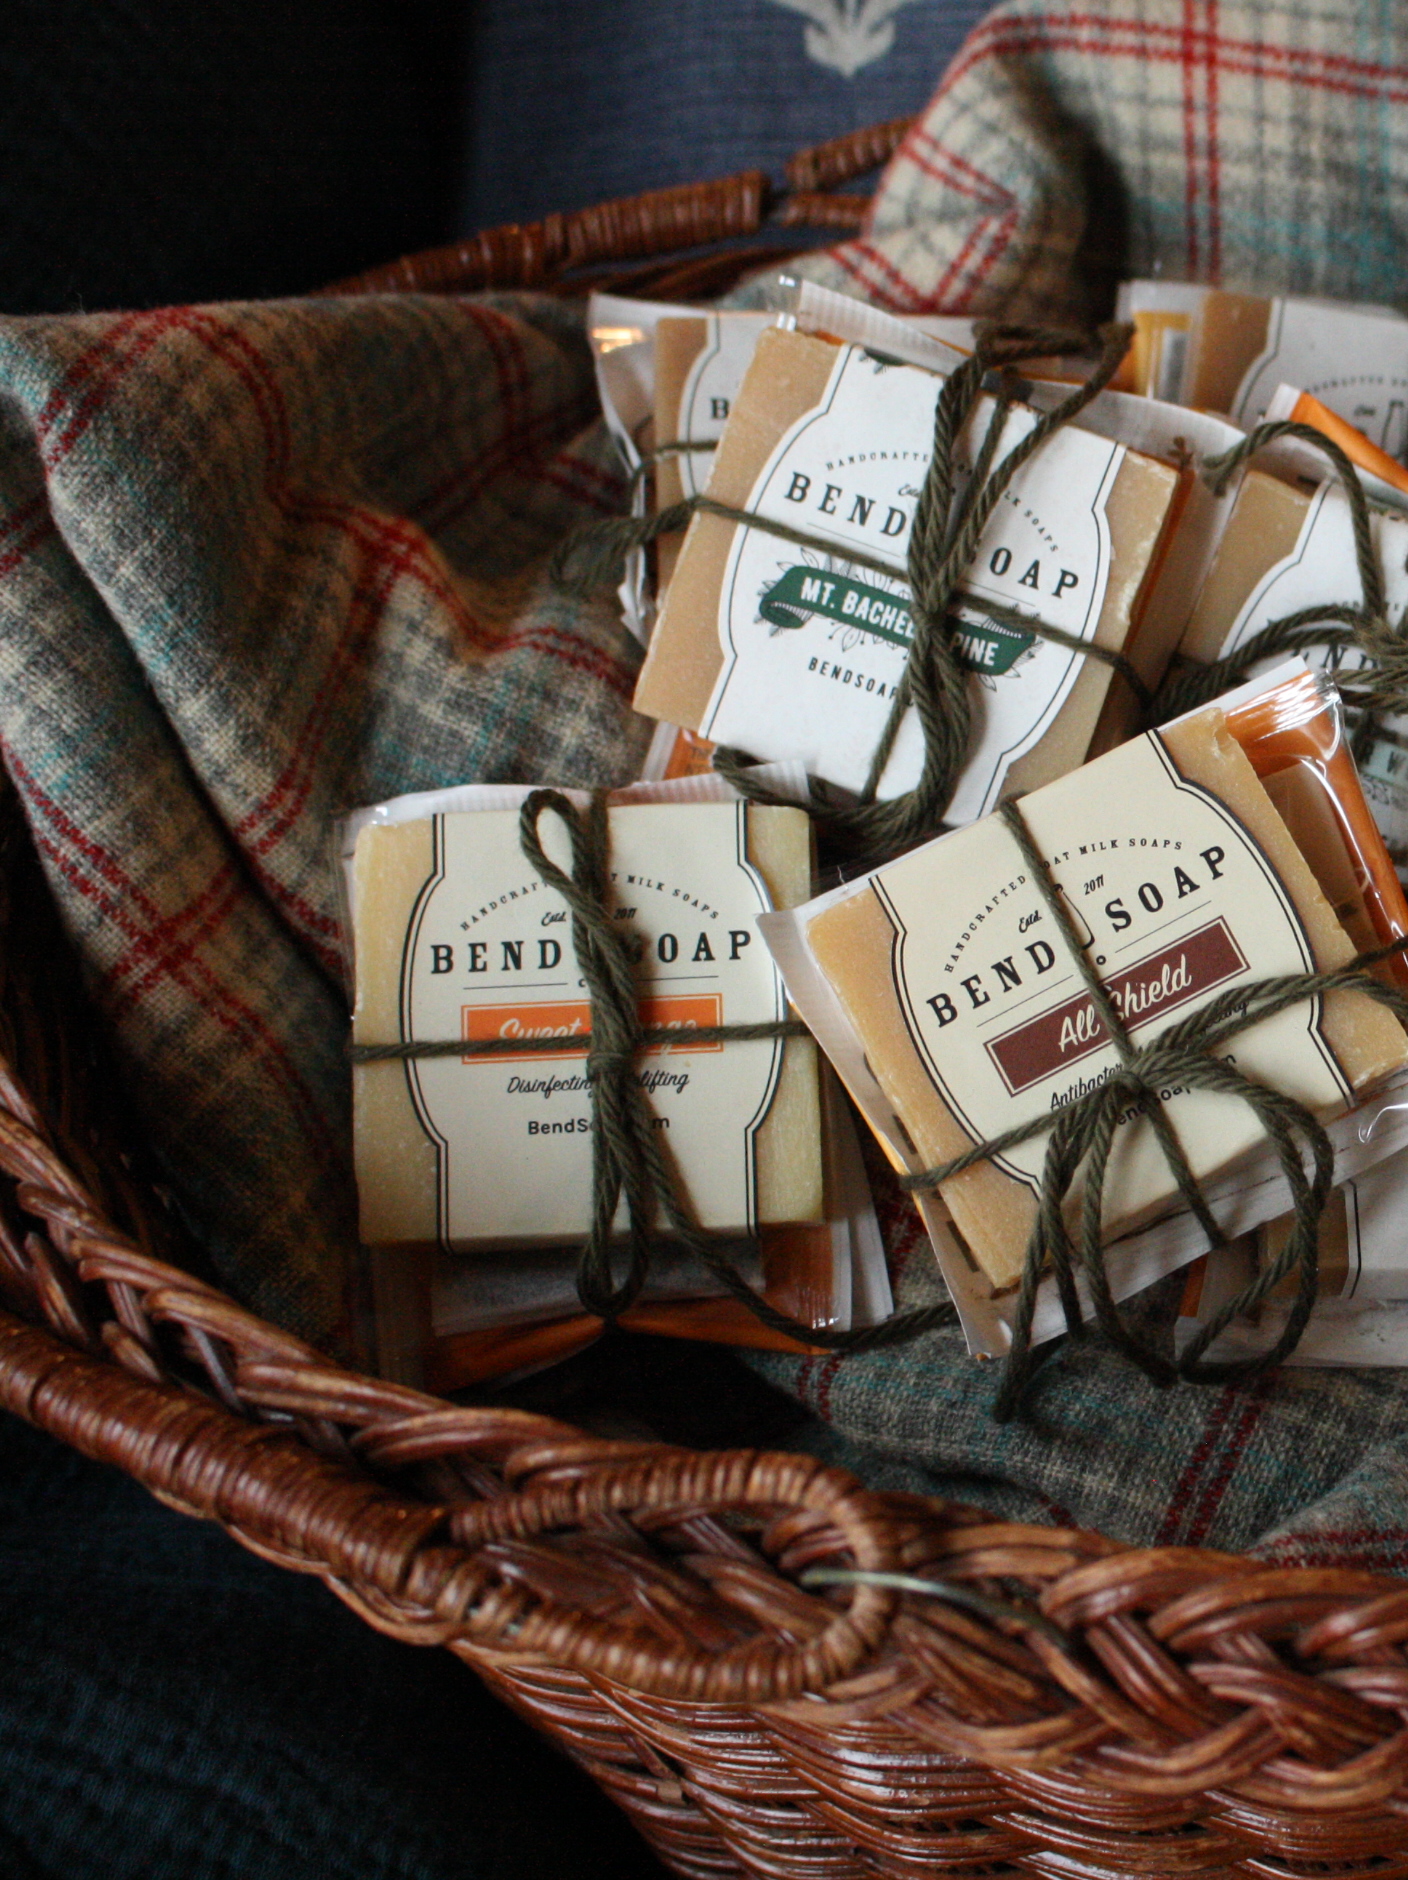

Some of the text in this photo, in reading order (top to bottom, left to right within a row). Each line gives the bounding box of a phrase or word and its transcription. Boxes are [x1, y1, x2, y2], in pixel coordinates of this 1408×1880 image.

[826, 450, 929, 472] HANDCRAFTE
[1023, 509, 1060, 553] SOAPS
[784, 470, 1080, 600] BEND OAP
[801, 576, 836, 609] MT.
[627, 875, 666, 891] MILK
[672, 888, 720, 920] SOAPS
[944, 837, 1183, 974] HANDCRAFTED OAT MILK SOAPS
[1083, 874, 1105, 896] 2011
[613, 907, 637, 920] 2011
[926, 845, 1226, 1029] BEND SOAP
[430, 929, 751, 975] BEND OAP
[1058, 1004, 1100, 1053] All
